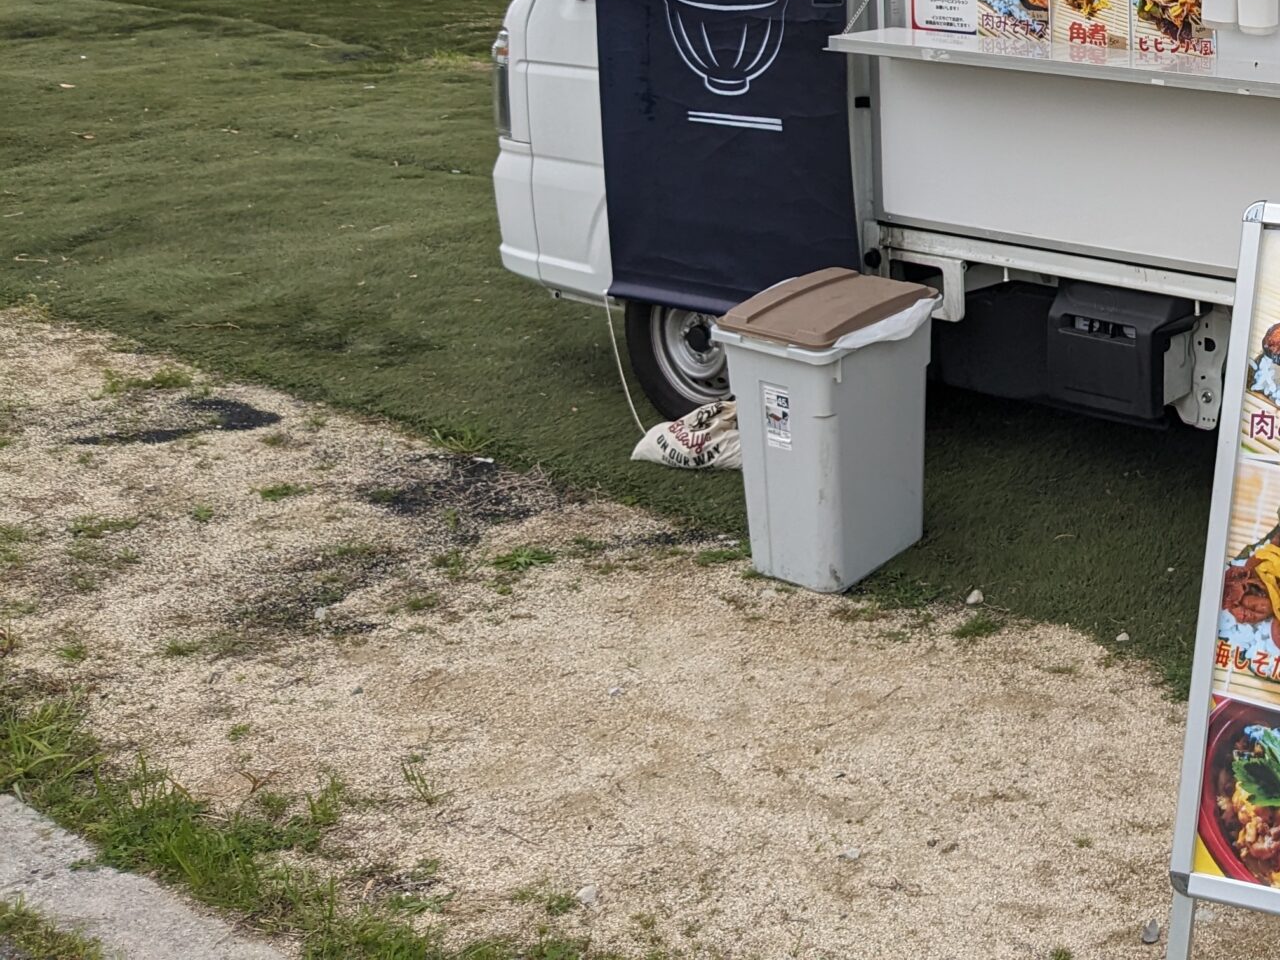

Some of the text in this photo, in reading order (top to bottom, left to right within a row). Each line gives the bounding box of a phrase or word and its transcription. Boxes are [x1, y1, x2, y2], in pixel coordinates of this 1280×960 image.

[982, 12, 1048, 37] 肉みそナス
[1068, 21, 1108, 46] 角煮
[1138, 35, 1215, 55] ビビンバ風
[656, 434, 669, 452] ON
[669, 448, 690, 467] OUR
[692, 443, 721, 467] WAY
